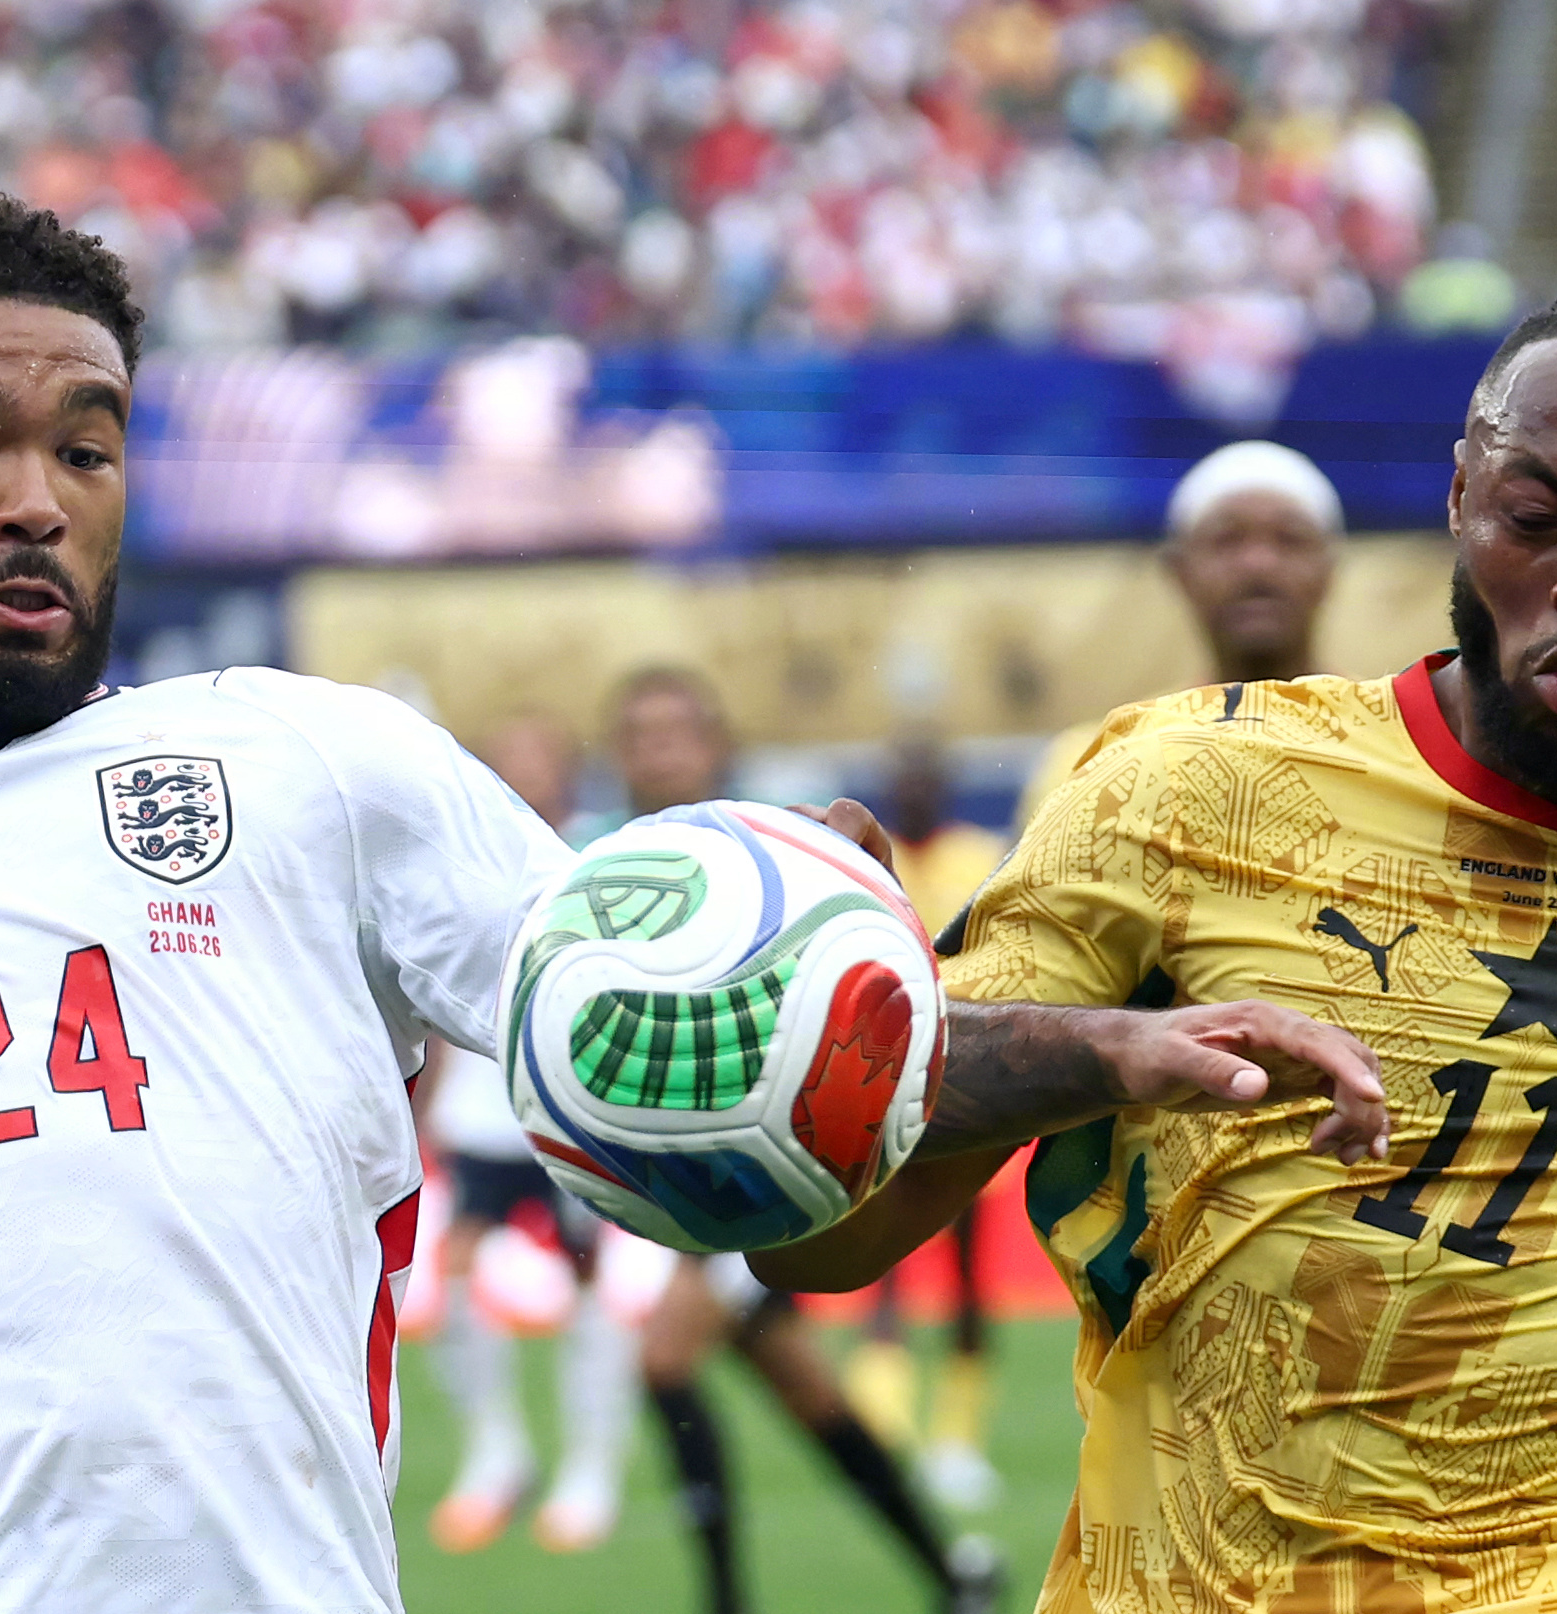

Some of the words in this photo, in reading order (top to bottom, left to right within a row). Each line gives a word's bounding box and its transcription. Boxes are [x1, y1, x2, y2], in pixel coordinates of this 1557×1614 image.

[1460, 858, 1546, 883] ENGLAND
[1502, 890, 1543, 908] June
[147, 901, 216, 928] GHANA
[149, 930, 221, 957] 23.06.26
